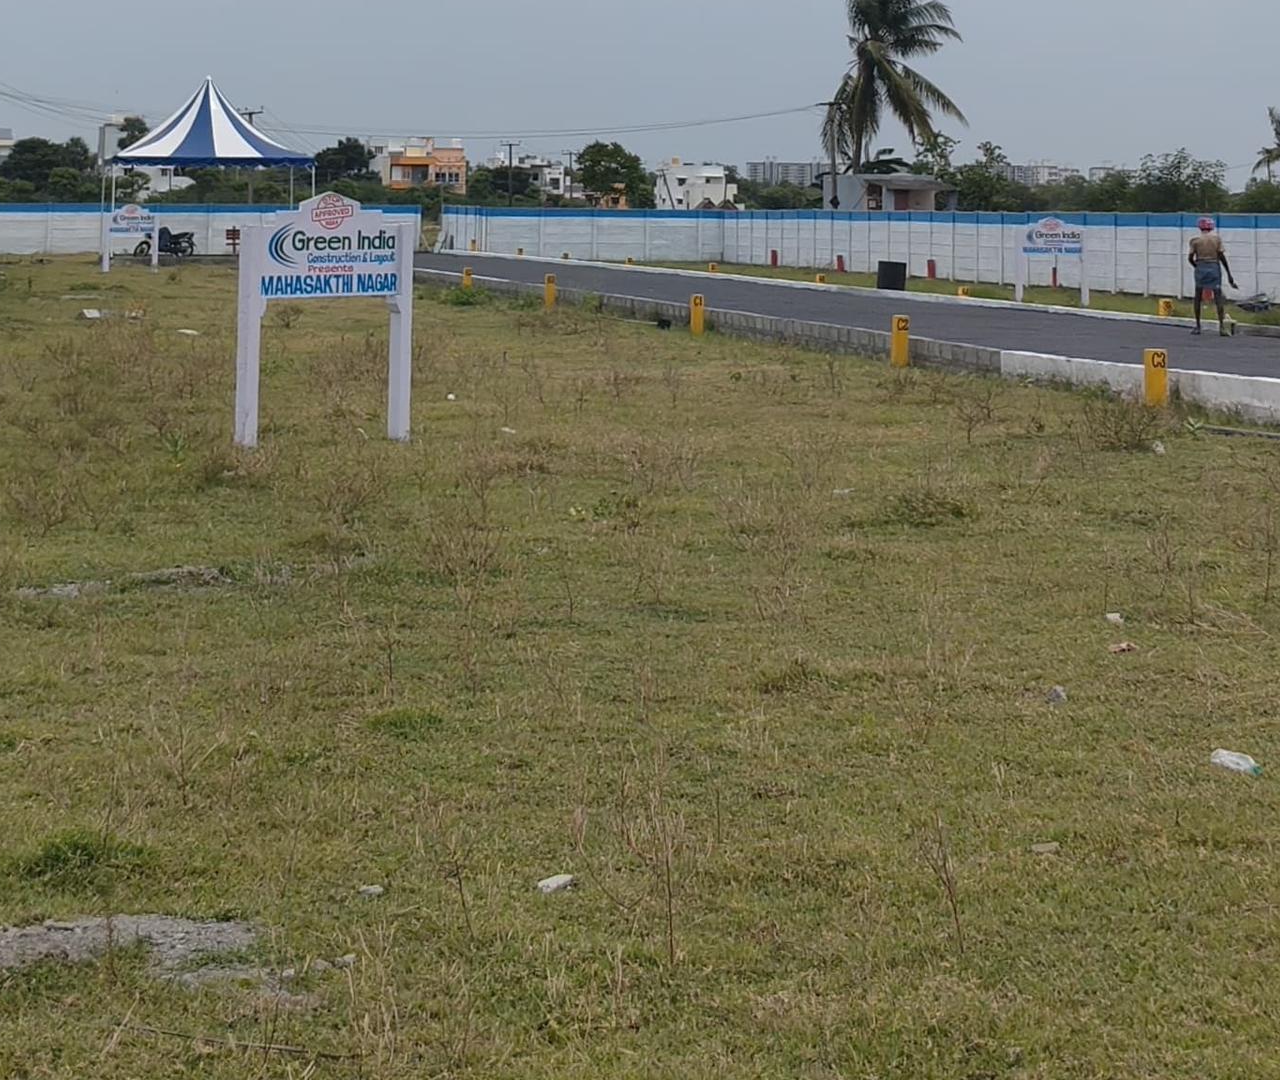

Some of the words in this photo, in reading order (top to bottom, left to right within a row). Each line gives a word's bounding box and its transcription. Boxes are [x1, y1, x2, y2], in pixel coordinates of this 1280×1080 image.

[315, 208, 350, 218] APPROVED
[292, 230, 352, 251] Green
[357, 229, 396, 250] India
[1035, 231, 1061, 239] Green
[307, 252, 361, 264] Construction
[362, 252, 368, 262] &
[369, 251, 396, 265] Layout
[308, 264, 354, 273] Presents
[261, 273, 353, 296] MAHASAKTHI
[357, 272, 398, 293] NAGAR
[897, 318, 909, 331] C2
[1152, 352, 1166, 368] C3
